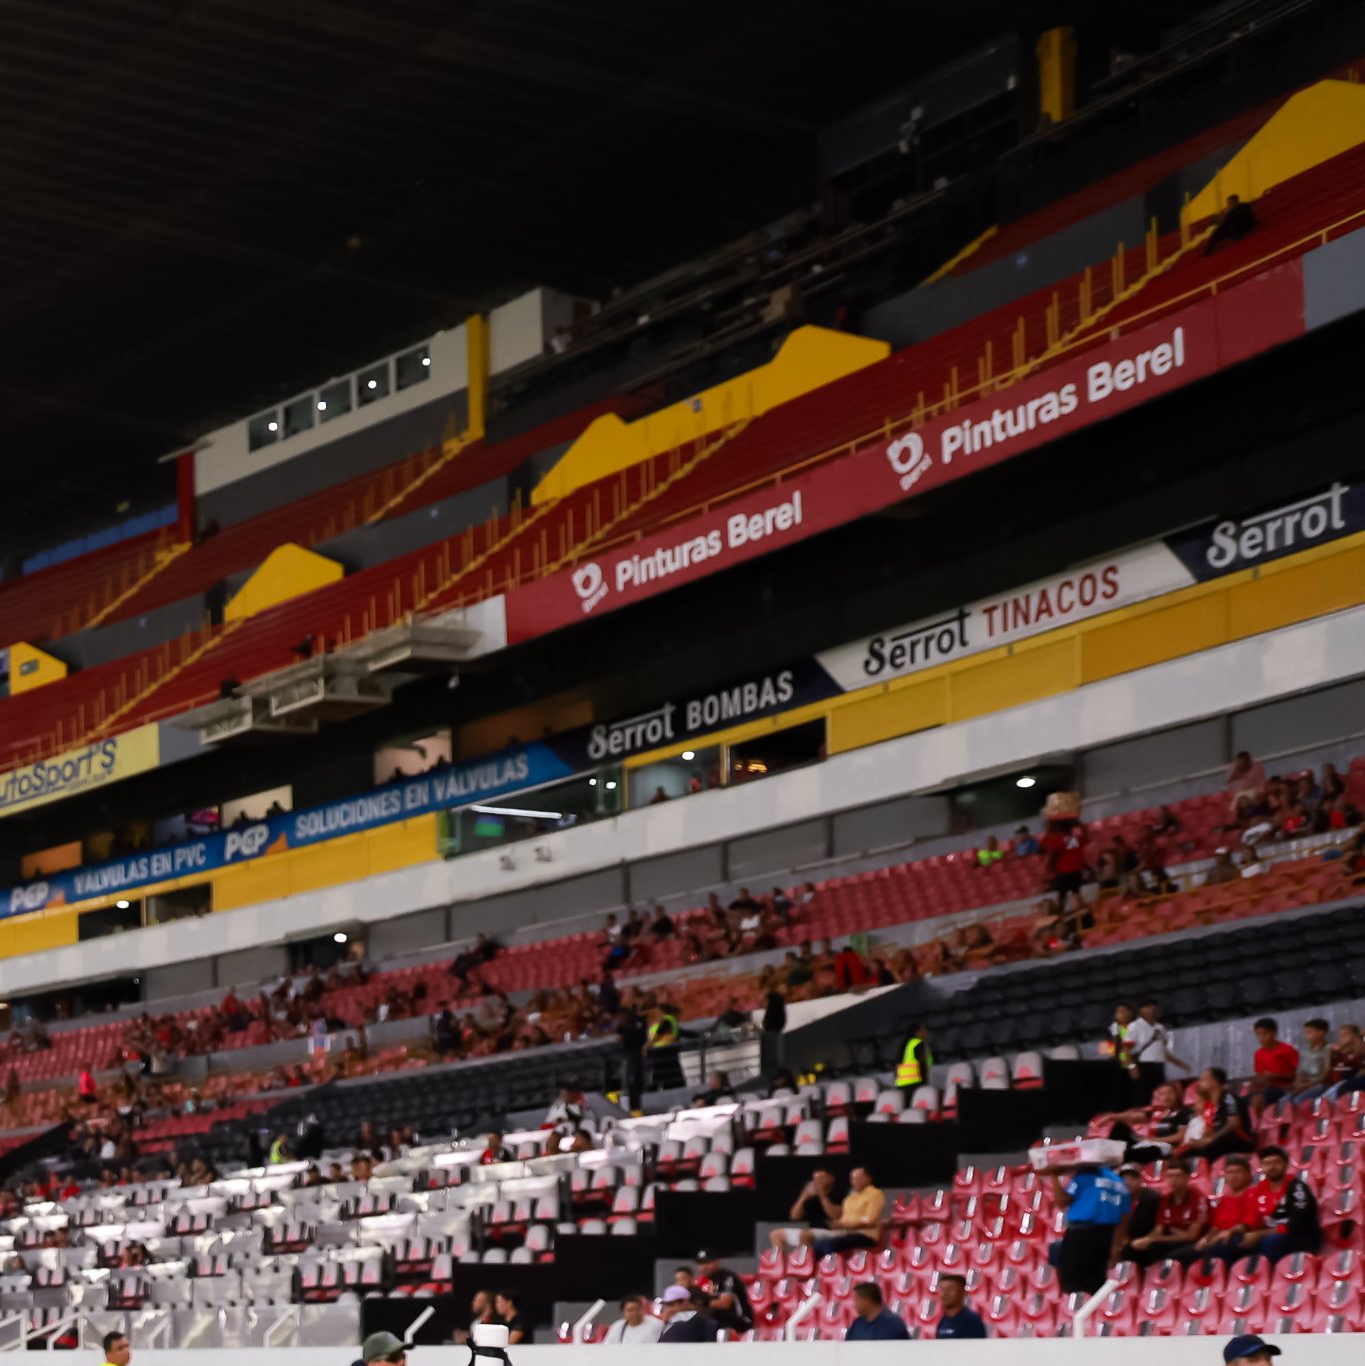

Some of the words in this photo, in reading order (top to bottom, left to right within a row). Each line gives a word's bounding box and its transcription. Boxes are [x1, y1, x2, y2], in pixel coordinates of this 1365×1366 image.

[940, 383, 1078, 464] Pinturas
[1087, 326, 1185, 402] Berel
[615, 530, 722, 592] Pinturas
[727, 489, 803, 548] Berel
[1206, 481, 1350, 568] Serrot
[863, 607, 971, 676] Serrot
[983, 564, 1119, 637] TINACOS
[587, 702, 676, 759] Serrot
[686, 670, 794, 731] BOMBAS
[405, 783, 430, 807] EN
[151, 853, 172, 877] EN
[174, 843, 207, 871] PVC
